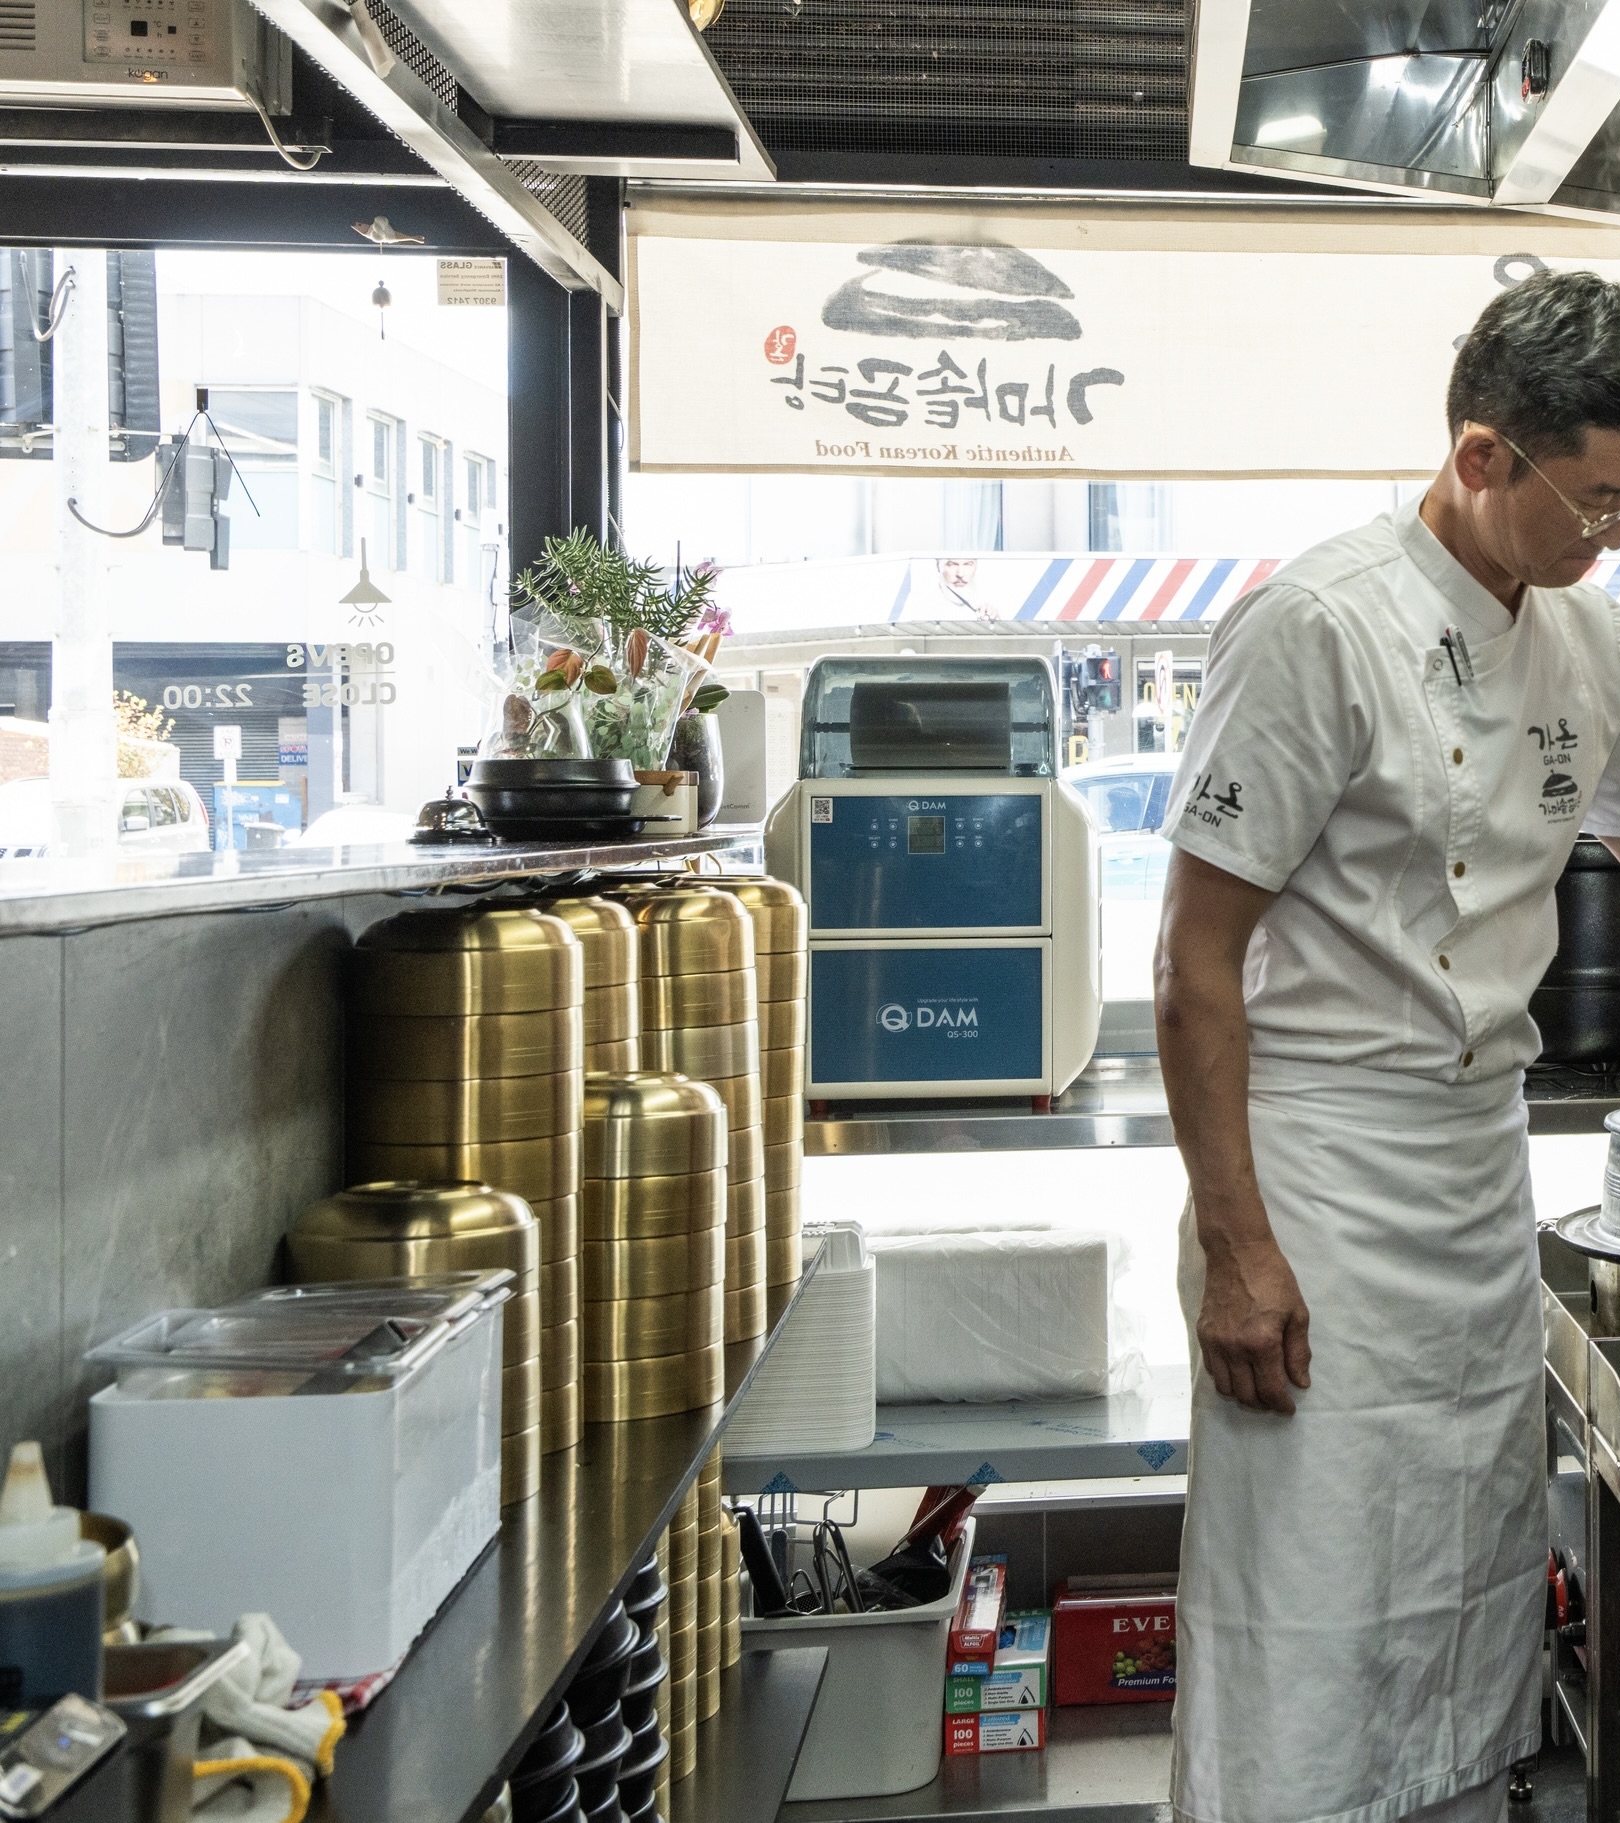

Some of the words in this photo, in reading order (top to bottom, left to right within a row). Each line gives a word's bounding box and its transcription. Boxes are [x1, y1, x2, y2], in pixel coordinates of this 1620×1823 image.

[128, 67, 169, 81] kogan
[1527, 718, 1578, 752] 가온
[1543, 753, 1572, 766] GA-ON
[917, 1007, 978, 1028] DAM
[947, 1030, 979, 1039] QS-300
[954, 1663, 969, 1673] 60
[1117, 1676, 1160, 1687] Premium
[954, 1687, 973, 1698] 100
[953, 1729, 973, 1740] 100
